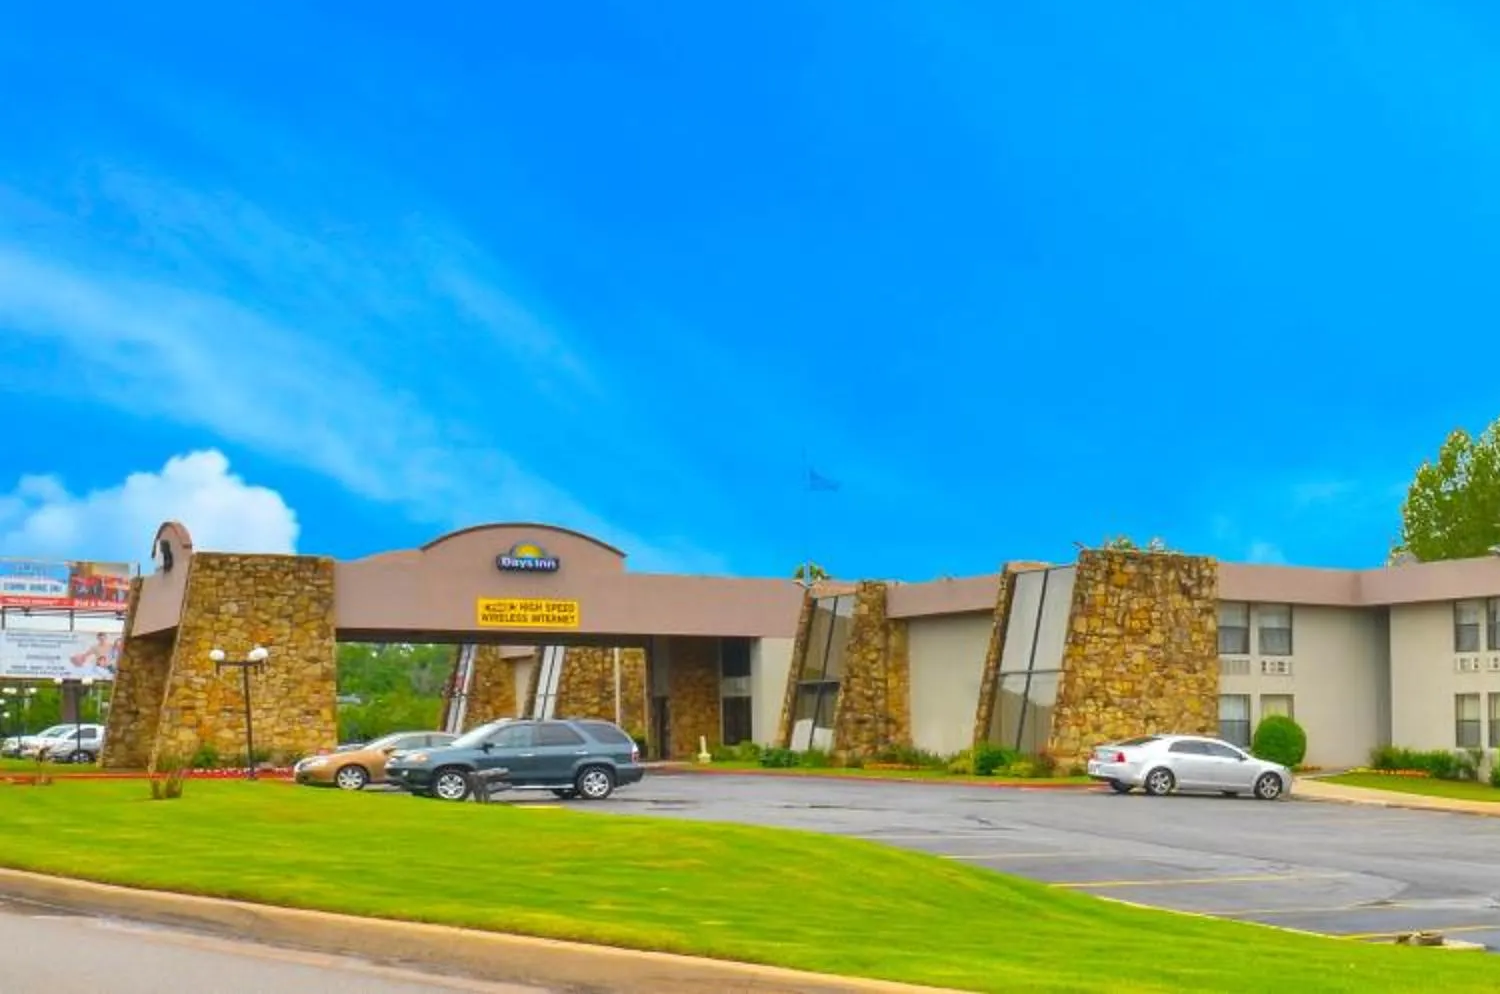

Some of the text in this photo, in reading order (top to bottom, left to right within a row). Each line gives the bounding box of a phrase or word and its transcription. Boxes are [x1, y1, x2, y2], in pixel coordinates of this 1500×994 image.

[501, 557, 557, 569] Days Inn
[519, 602, 543, 612] HIGH
[546, 603, 576, 613] SPEED
[481, 613, 575, 624] WIRELESS INTERNET
